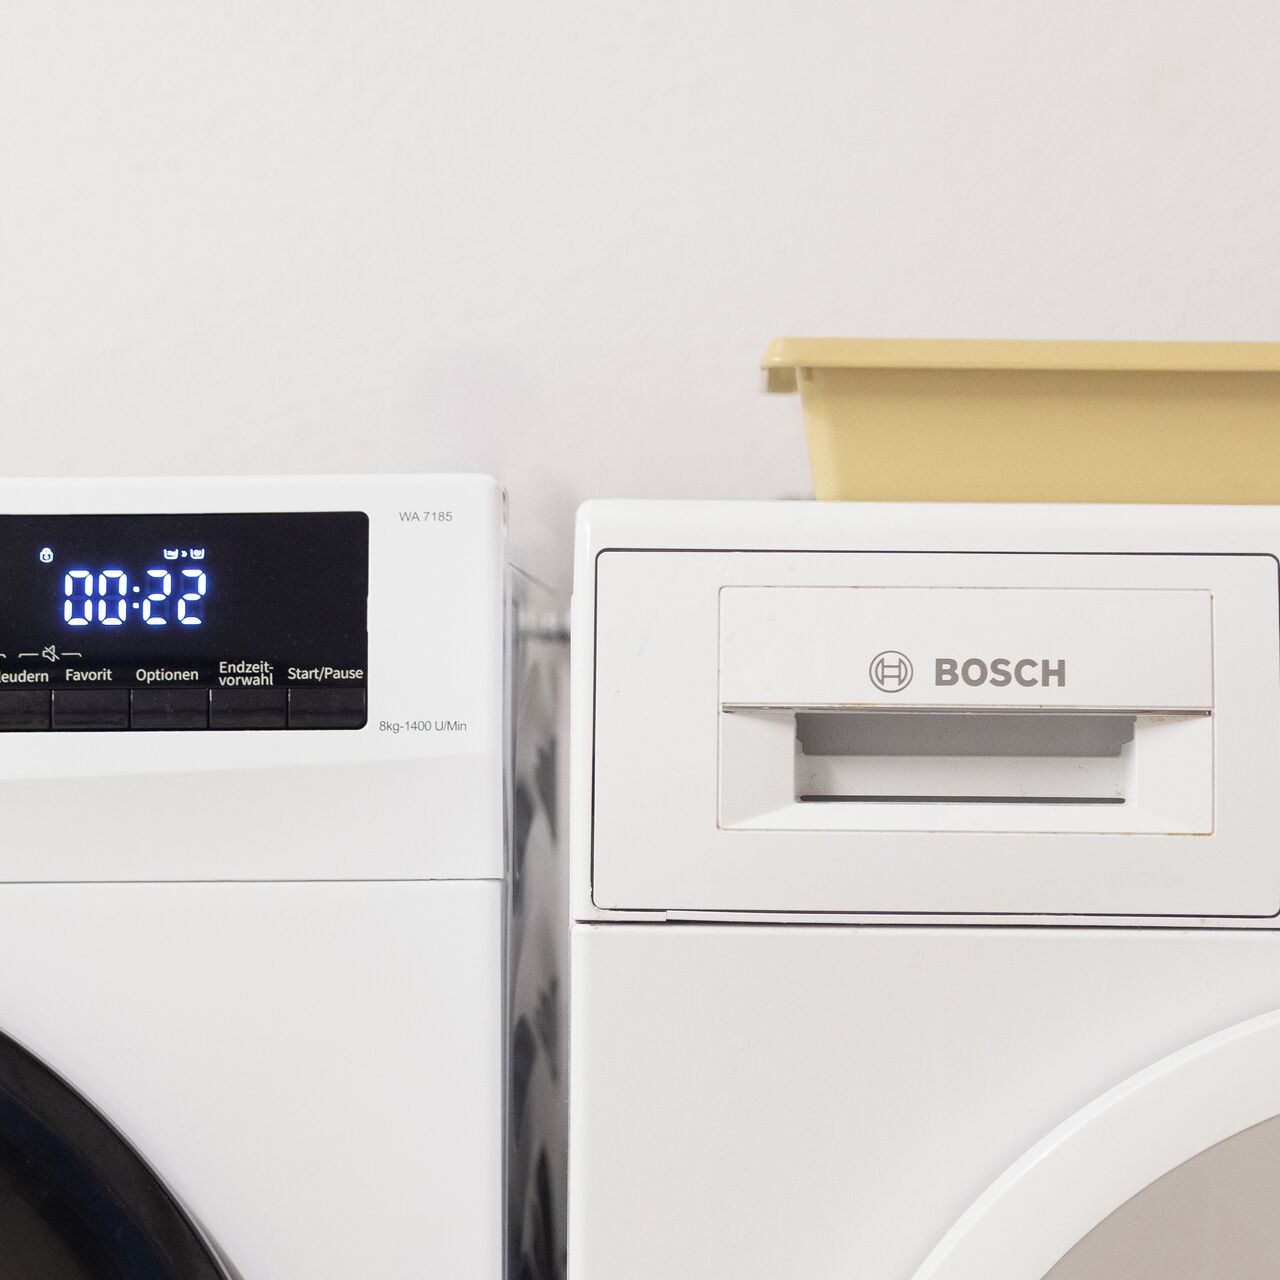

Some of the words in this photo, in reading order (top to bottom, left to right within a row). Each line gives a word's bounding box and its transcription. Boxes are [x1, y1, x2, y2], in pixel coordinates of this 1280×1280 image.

[399, 512, 419, 522] WA
[423, 511, 453, 522] 7185
[64, 569, 206, 626] 00:22
[219, 660, 274, 674] Endzeit-
[287, 666, 363, 681] Start/Pause
[935, 658, 1065, 687] BOSCH
[65, 668, 112, 682] Favorit
[136, 668, 199, 684] Optionen
[219, 673, 274, 687] vorwahl
[379, 720, 432, 735] 8kg-1400
[435, 719, 467, 732] U/Min
